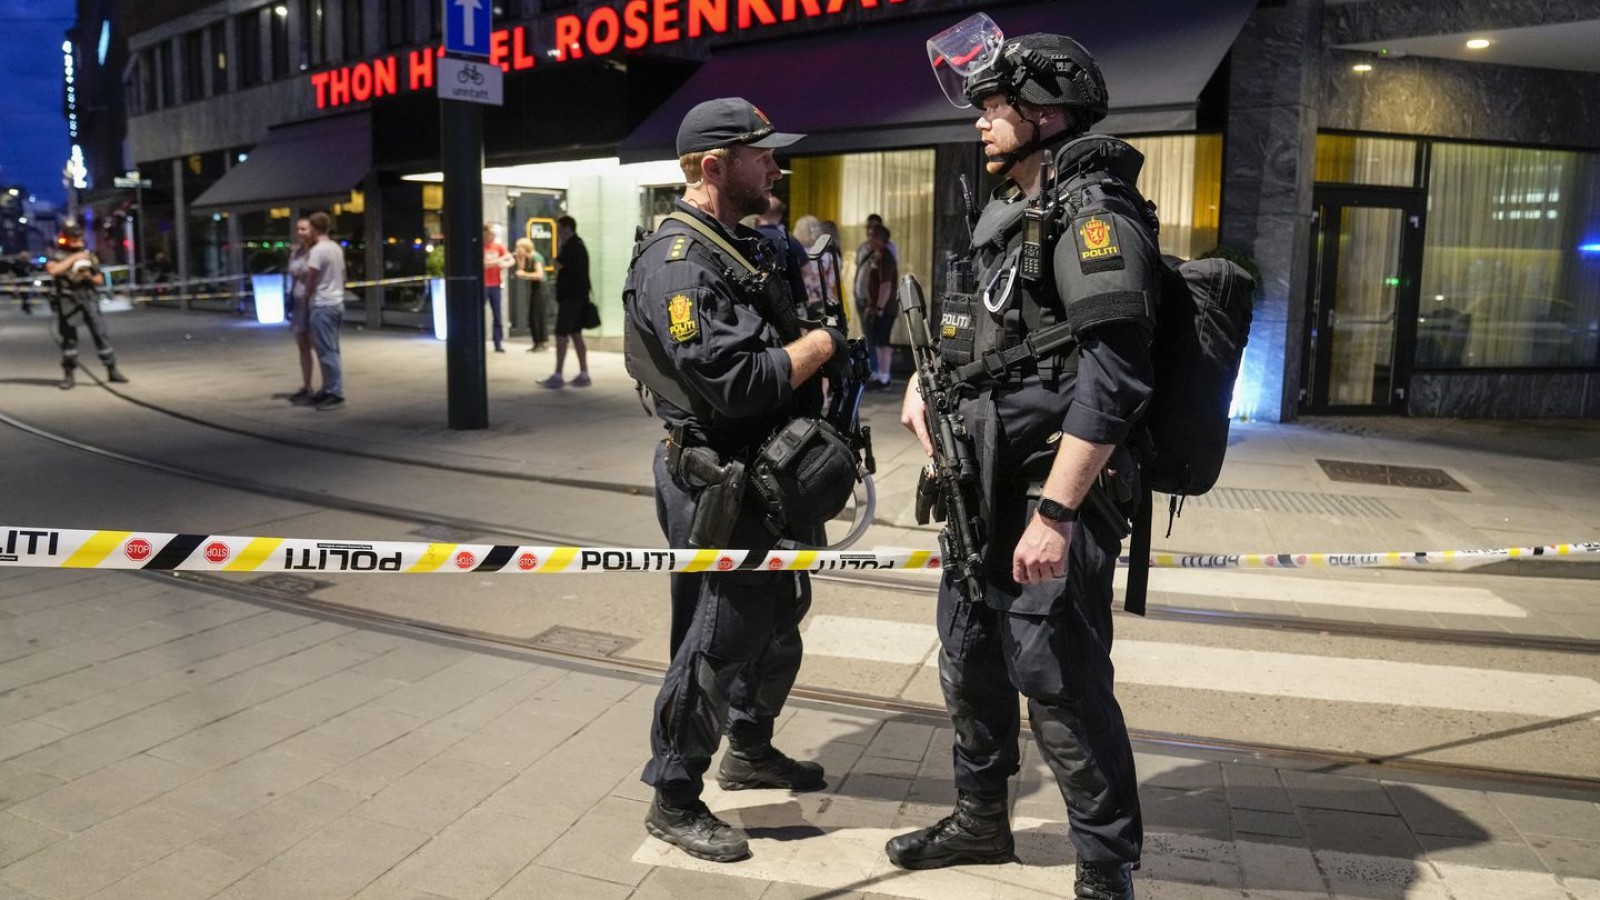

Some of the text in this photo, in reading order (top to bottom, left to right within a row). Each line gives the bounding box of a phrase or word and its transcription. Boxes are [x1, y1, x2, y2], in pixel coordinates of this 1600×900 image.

[311, 56, 397, 110] THON
[409, 26, 534, 90] HEL
[1082, 246, 1118, 259] POLITI
[670, 320, 696, 335] POLITI
[941, 313, 970, 328] POLITI
[0, 530, 59, 556] ITI
[127, 543, 150, 555] STOP
[206, 548, 228, 558] STOP
[284, 547, 402, 571] POLITI
[581, 550, 676, 571] POLITI
[519, 556, 536, 566] STOP
